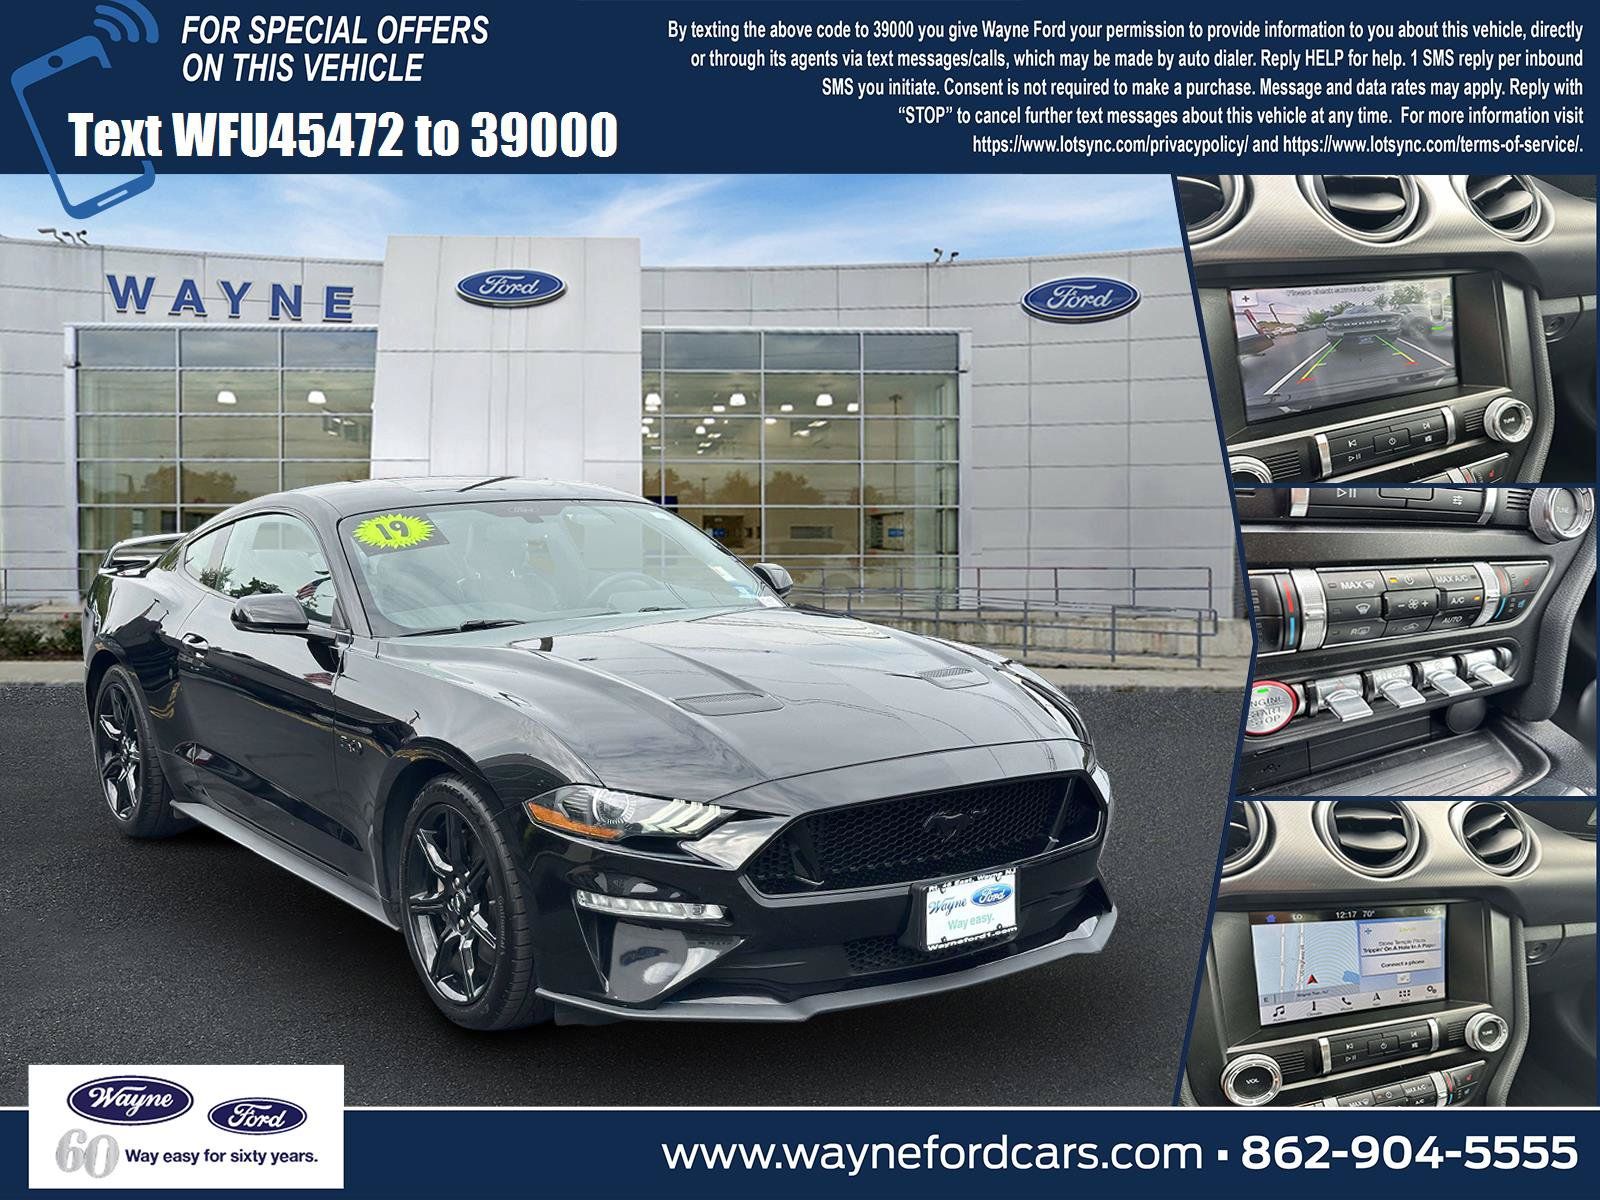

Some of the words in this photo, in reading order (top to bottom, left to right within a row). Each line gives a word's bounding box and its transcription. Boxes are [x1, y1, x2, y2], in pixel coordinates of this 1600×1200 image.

[479, 274, 540, 295] Ford
[106, 274, 355, 322] WAYNE
[1046, 284, 1114, 309] Ford
[375, 520, 411, 541] 19
[1340, 580, 1364, 590] MAX
[1436, 576, 1453, 584] MAX
[1454, 573, 1469, 582] A/C
[1450, 597, 1465, 605] A/C
[1441, 615, 1463, 624] AUTO
[978, 888, 1006, 904] Ford
[928, 897, 967, 916] Wayne
[947, 918, 969, 930] Way
[970, 913, 995, 926] easy.
[1336, 911, 1357, 919] 12:17
[1381, 961, 1404, 969] Connect
[1246, 1077, 1260, 1085] VOL
